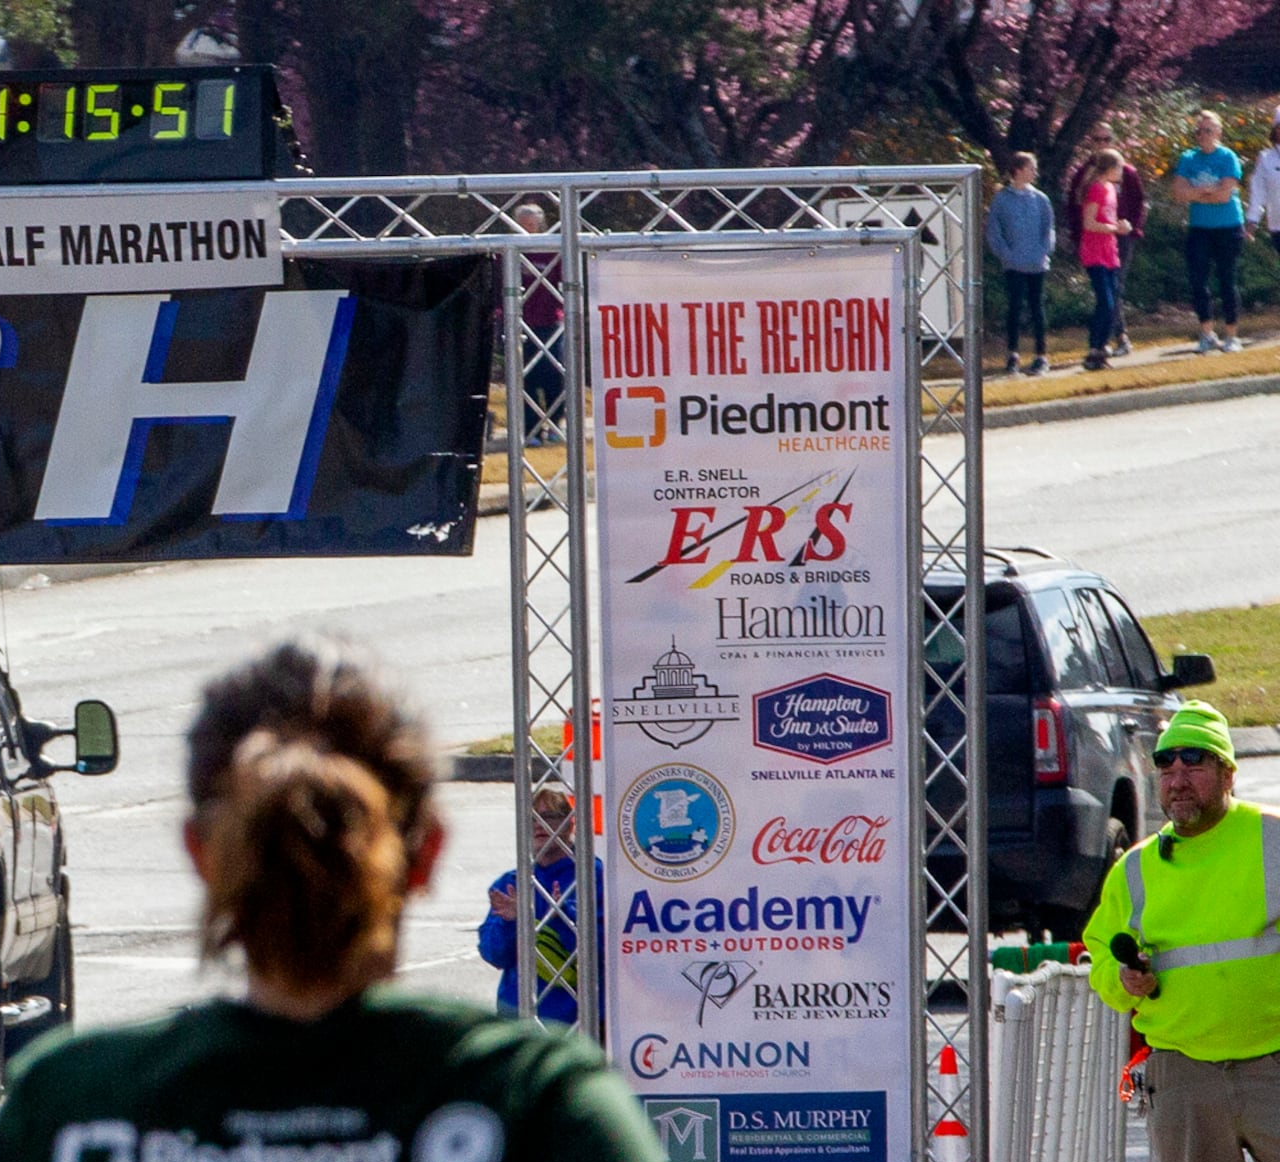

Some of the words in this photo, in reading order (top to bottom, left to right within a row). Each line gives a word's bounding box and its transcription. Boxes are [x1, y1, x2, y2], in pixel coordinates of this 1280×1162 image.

[60, 219, 267, 265] MARATHON
[598, 302, 670, 379] RUN
[682, 301, 747, 376] THE
[757, 297, 890, 374] REAGAN
[679, 392, 890, 436] Piedmont
[778, 436, 890, 453] HEALTHCARE
[664, 470, 693, 482] E.R.
[698, 468, 748, 481] SNELL
[653, 486, 760, 501] CONTRACTOR
[730, 571, 786, 585] ROADS
[790, 571, 800, 584] &
[805, 570, 871, 583] BRIDGES
[715, 596, 886, 640] Hamilton
[766, 651, 831, 659] FINANCIAL
[836, 650, 885, 658] SERVICES
[612, 702, 740, 717] SNELLVILLE
[774, 693, 870, 718] Hampton
[770, 718, 819, 739] Inn
[819, 722, 831, 736] &
[830, 715, 879, 735] Suites
[797, 742, 810, 751] by
[813, 741, 852, 750] HILTON
[751, 770, 822, 780] SNELLVILLE
[825, 769, 877, 779] ATLANTA
[881, 769, 896, 779] NE
[752, 815, 891, 865] Coca-Cola
[653, 866, 698, 878] GEORGIA
[622, 886, 873, 943] Academy
[752, 981, 892, 1009] BARRON'S
[753, 1010, 796, 1020] FINE
[801, 1008, 891, 1020] JEWELRY
[630, 1033, 810, 1080] CANNON
[680, 1069, 715, 1078] UNITED
[717, 1069, 769, 1078] METHODIST
[771, 1069, 811, 1078] CHURCH
[729, 1111, 769, 1129] D.S.
[774, 1109, 872, 1128] MURPHY
[731, 1134, 793, 1142] RESIDENTIAL
[806, 1132, 867, 1141] COMMERCIAL
[729, 1147, 747, 1155] Real
[748, 1147, 773, 1155] Estate
[774, 1146, 816, 1156] Appraisers
[826, 1145, 870, 1154] Consultants
